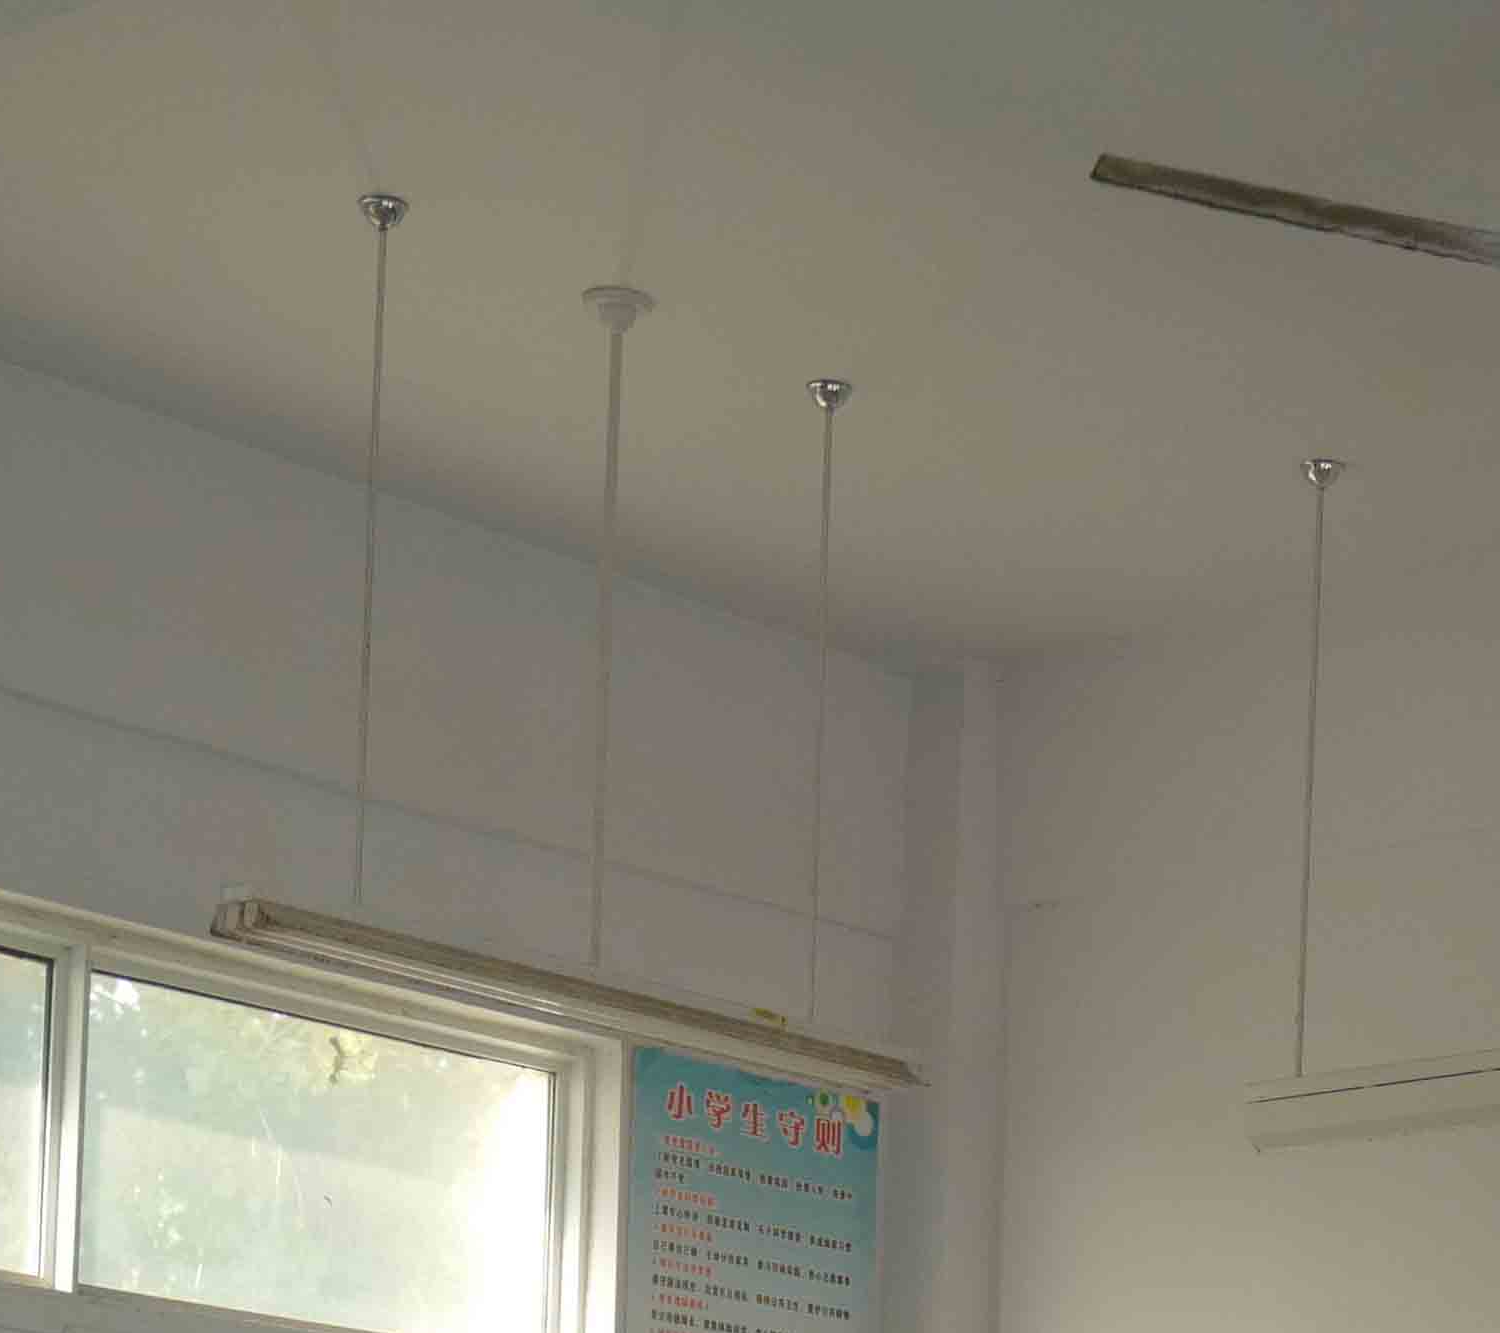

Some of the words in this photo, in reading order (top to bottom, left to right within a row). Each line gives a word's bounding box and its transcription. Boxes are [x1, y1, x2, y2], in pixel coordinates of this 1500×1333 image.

[667, 1082, 844, 1155] 小学生守则
